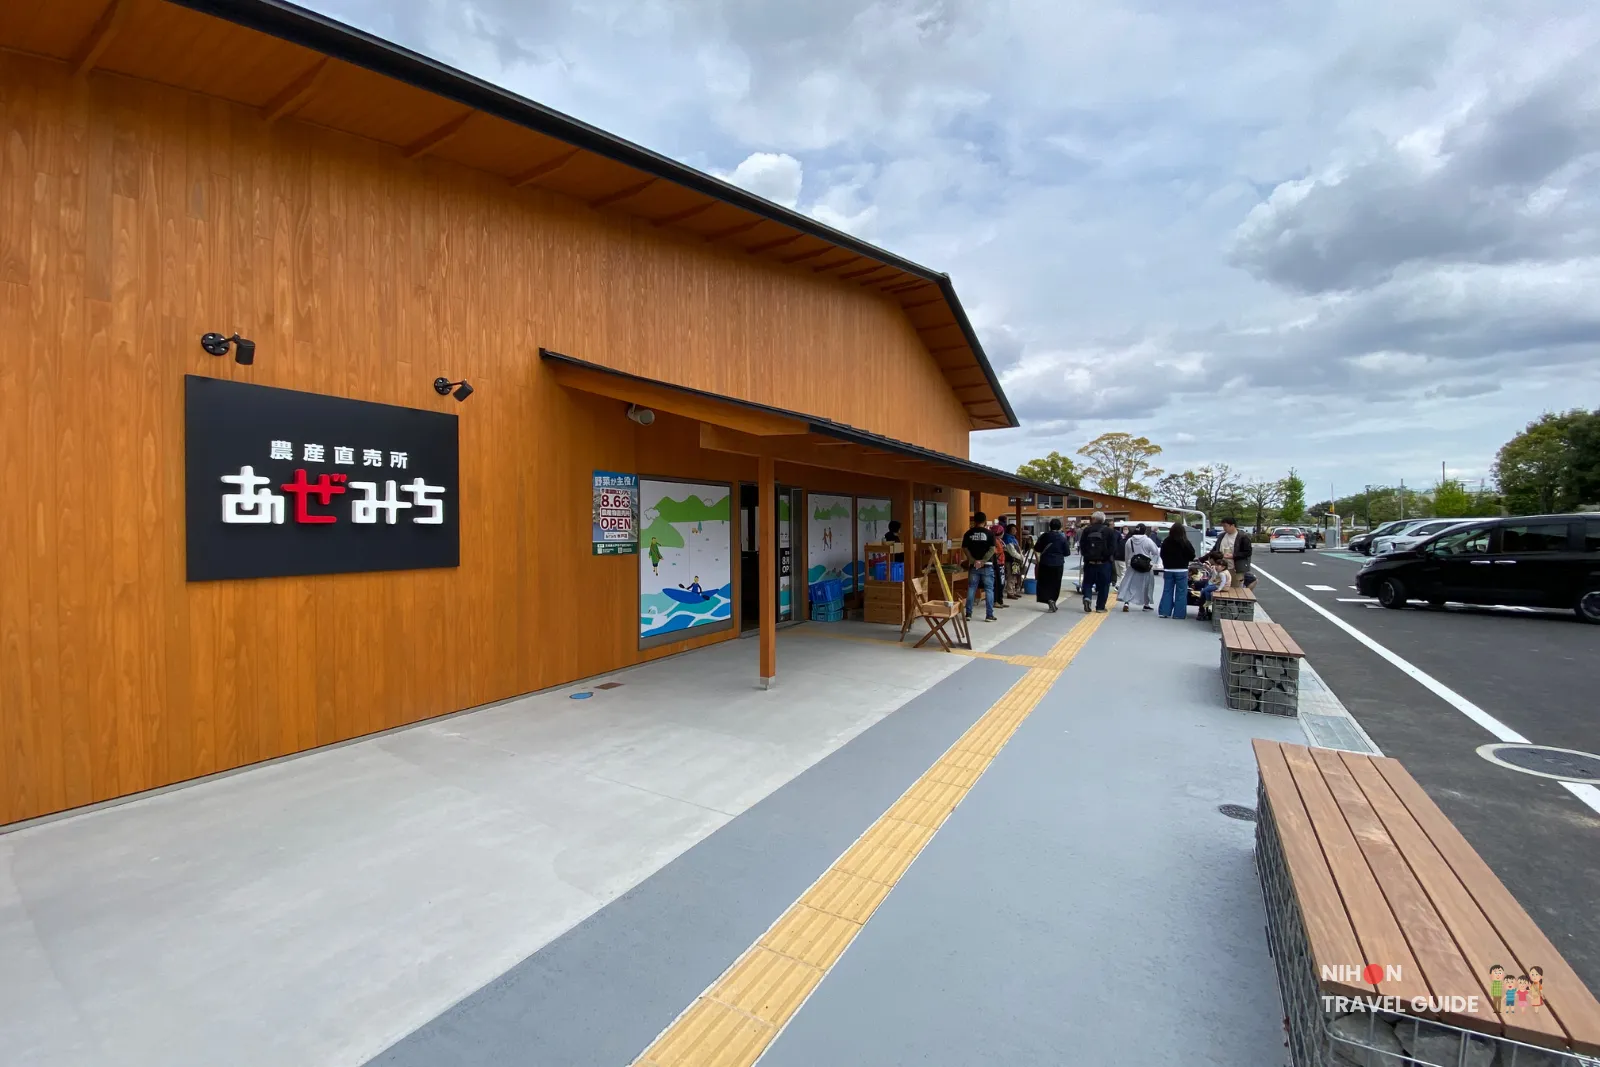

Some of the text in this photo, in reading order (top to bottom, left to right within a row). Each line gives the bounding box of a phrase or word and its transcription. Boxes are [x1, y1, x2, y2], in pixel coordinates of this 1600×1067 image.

[269, 439, 409, 470] 農産直売所
[220, 465, 446, 525] あぜみち
[600, 518, 631, 530] OPEN
